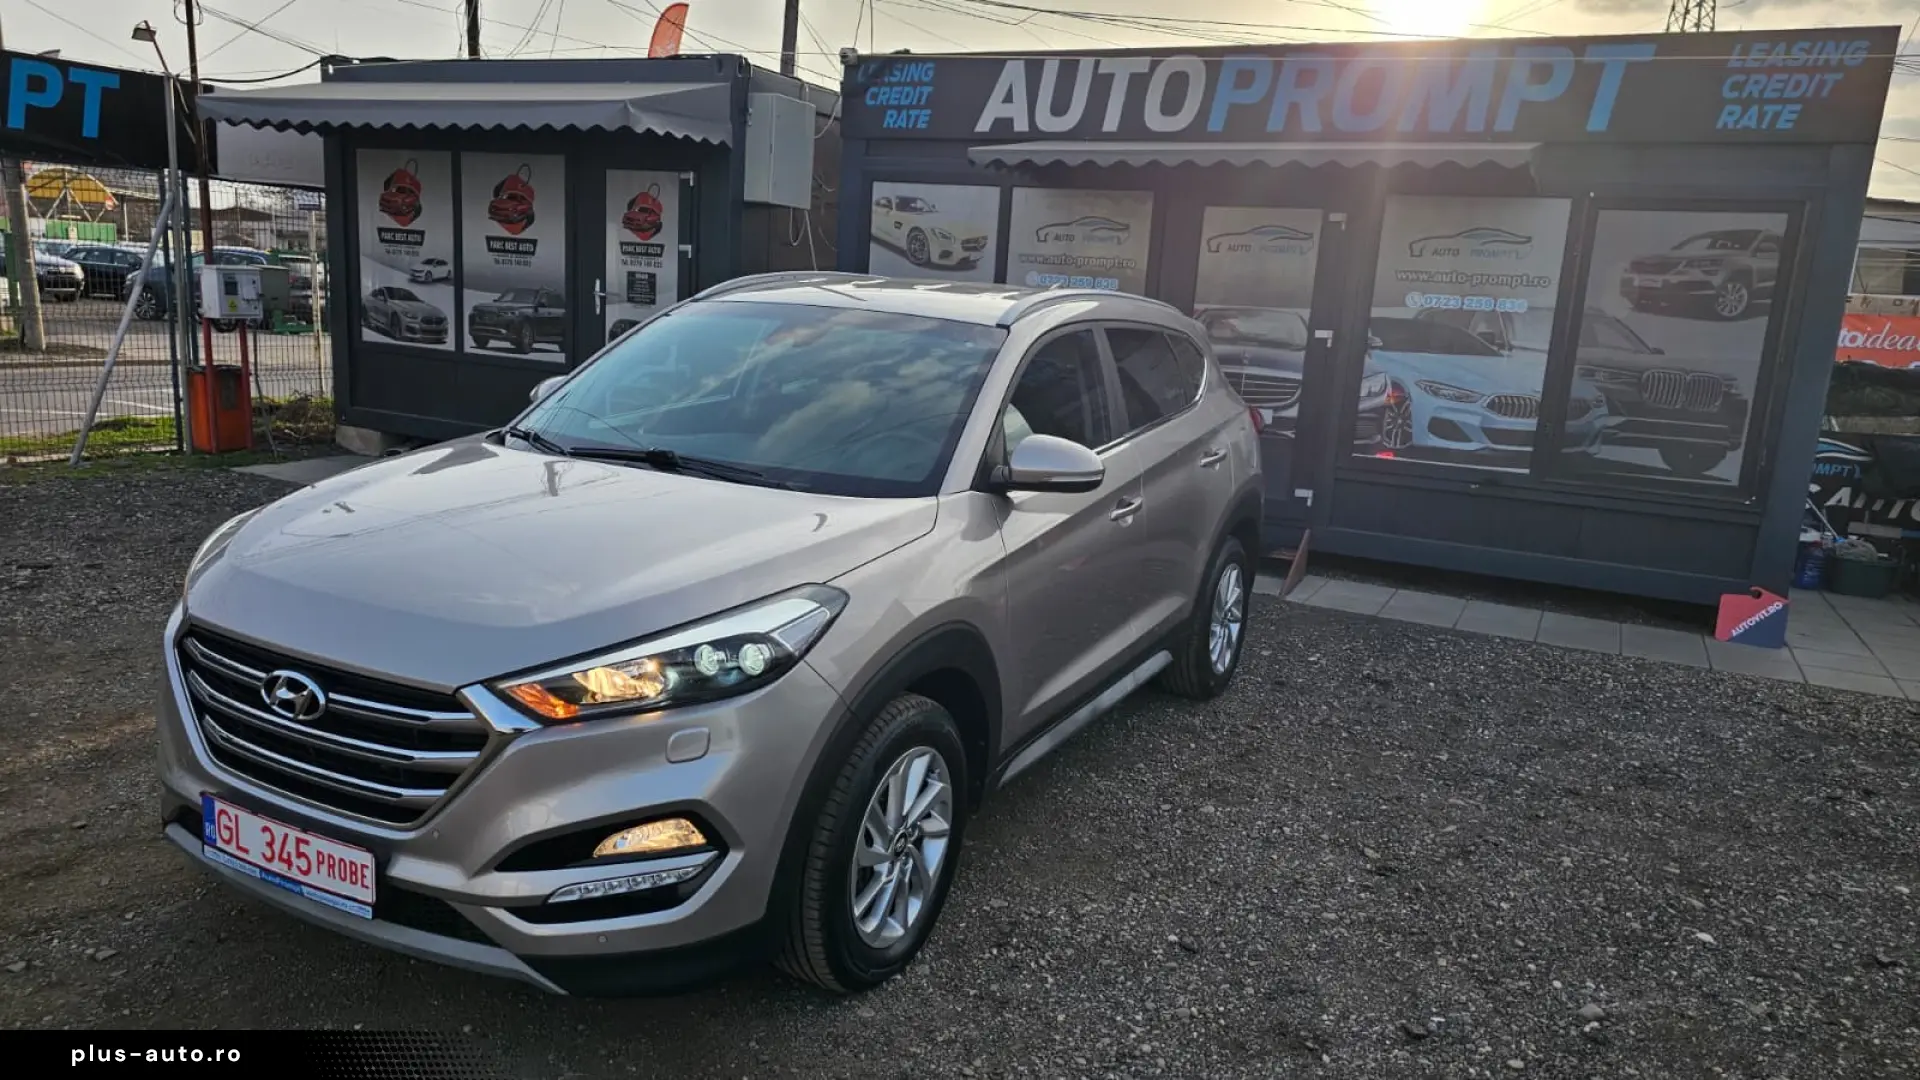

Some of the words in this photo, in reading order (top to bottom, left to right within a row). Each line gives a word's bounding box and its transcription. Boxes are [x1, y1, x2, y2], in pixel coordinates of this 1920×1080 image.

[1728, 40, 1870, 67] LEASING
[857, 62, 936, 83] LSING
[7, 57, 120, 138] PT
[865, 86, 934, 106] CREDIT
[1722, 73, 1843, 99] CREDIT
[883, 108, 932, 129] RATE
[1716, 103, 1803, 129] RATE
[217, 809, 249, 854] GL
[260, 825, 312, 877] 345
[316, 849, 370, 890] PROBE
